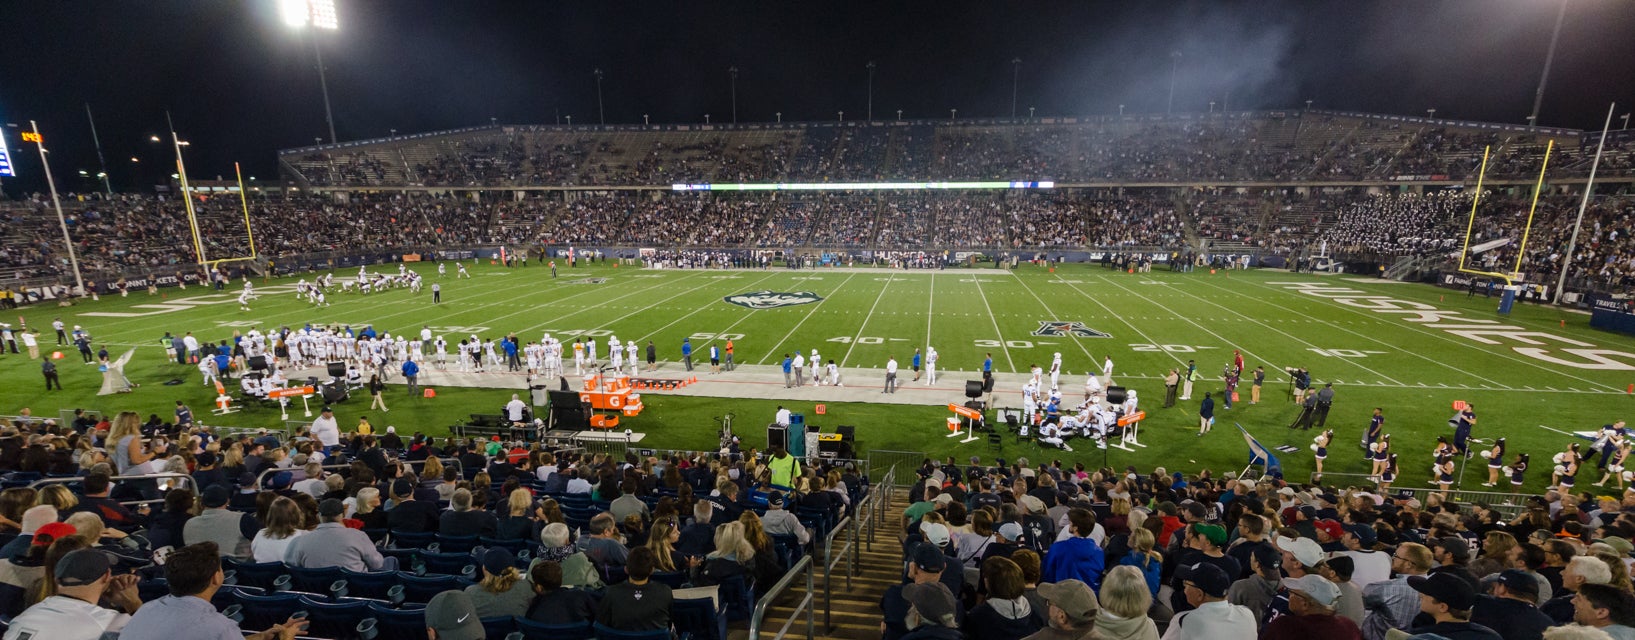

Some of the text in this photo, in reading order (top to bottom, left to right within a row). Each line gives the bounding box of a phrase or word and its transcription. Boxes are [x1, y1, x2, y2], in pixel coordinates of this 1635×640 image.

[1265, 281, 1635, 371] HUSKIES
[557, 329, 614, 337] 40
[688, 332, 746, 340] 50
[826, 336, 884, 344] 40
[973, 339, 1034, 348] 30
[1128, 343, 1196, 353] 20
[1306, 348, 1368, 358] 10
[609, 395, 620, 407] G
[1455, 401, 1464, 409] 10
